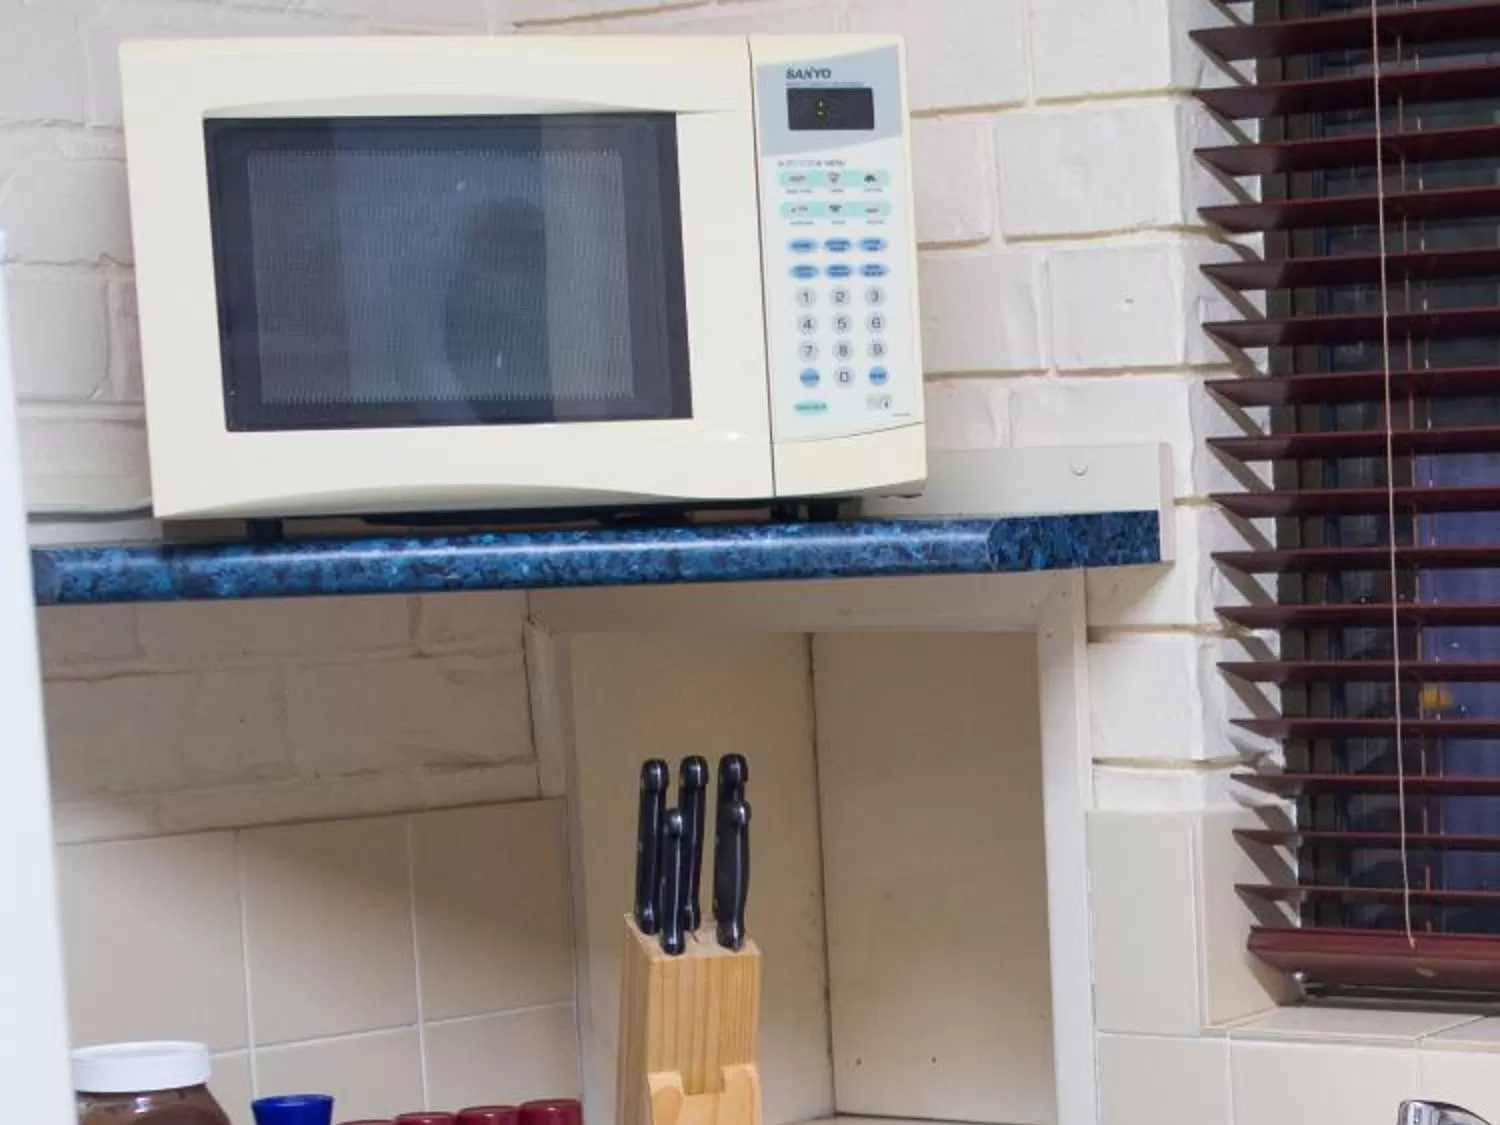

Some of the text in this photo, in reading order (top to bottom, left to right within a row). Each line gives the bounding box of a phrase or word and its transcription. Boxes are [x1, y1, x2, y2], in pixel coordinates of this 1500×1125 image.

[785, 68, 832, 80] SANYO
[835, 291, 845, 303] 2
[803, 317, 881, 330] 4 5 6
[804, 344, 813, 356] 7
